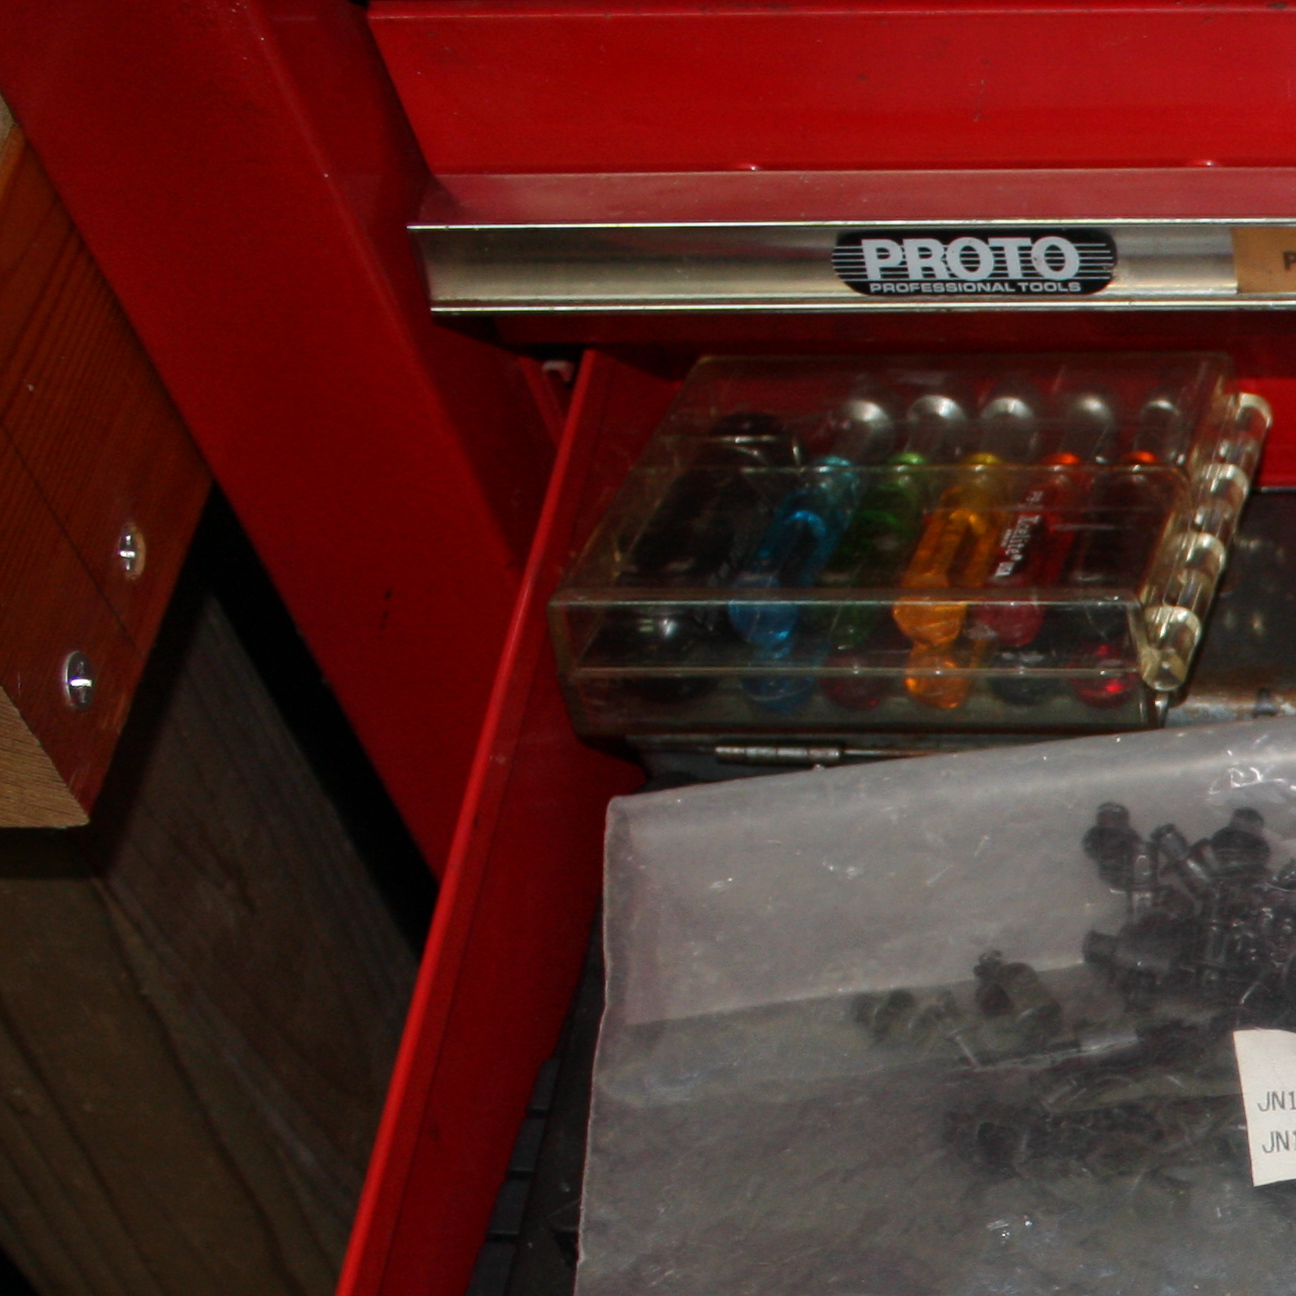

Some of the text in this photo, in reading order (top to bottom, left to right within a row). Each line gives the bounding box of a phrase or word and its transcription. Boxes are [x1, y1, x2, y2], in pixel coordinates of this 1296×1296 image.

[861, 236, 1080, 281] PROTO
[870, 281, 1082, 293] PROFESSIONAL TOOLS
